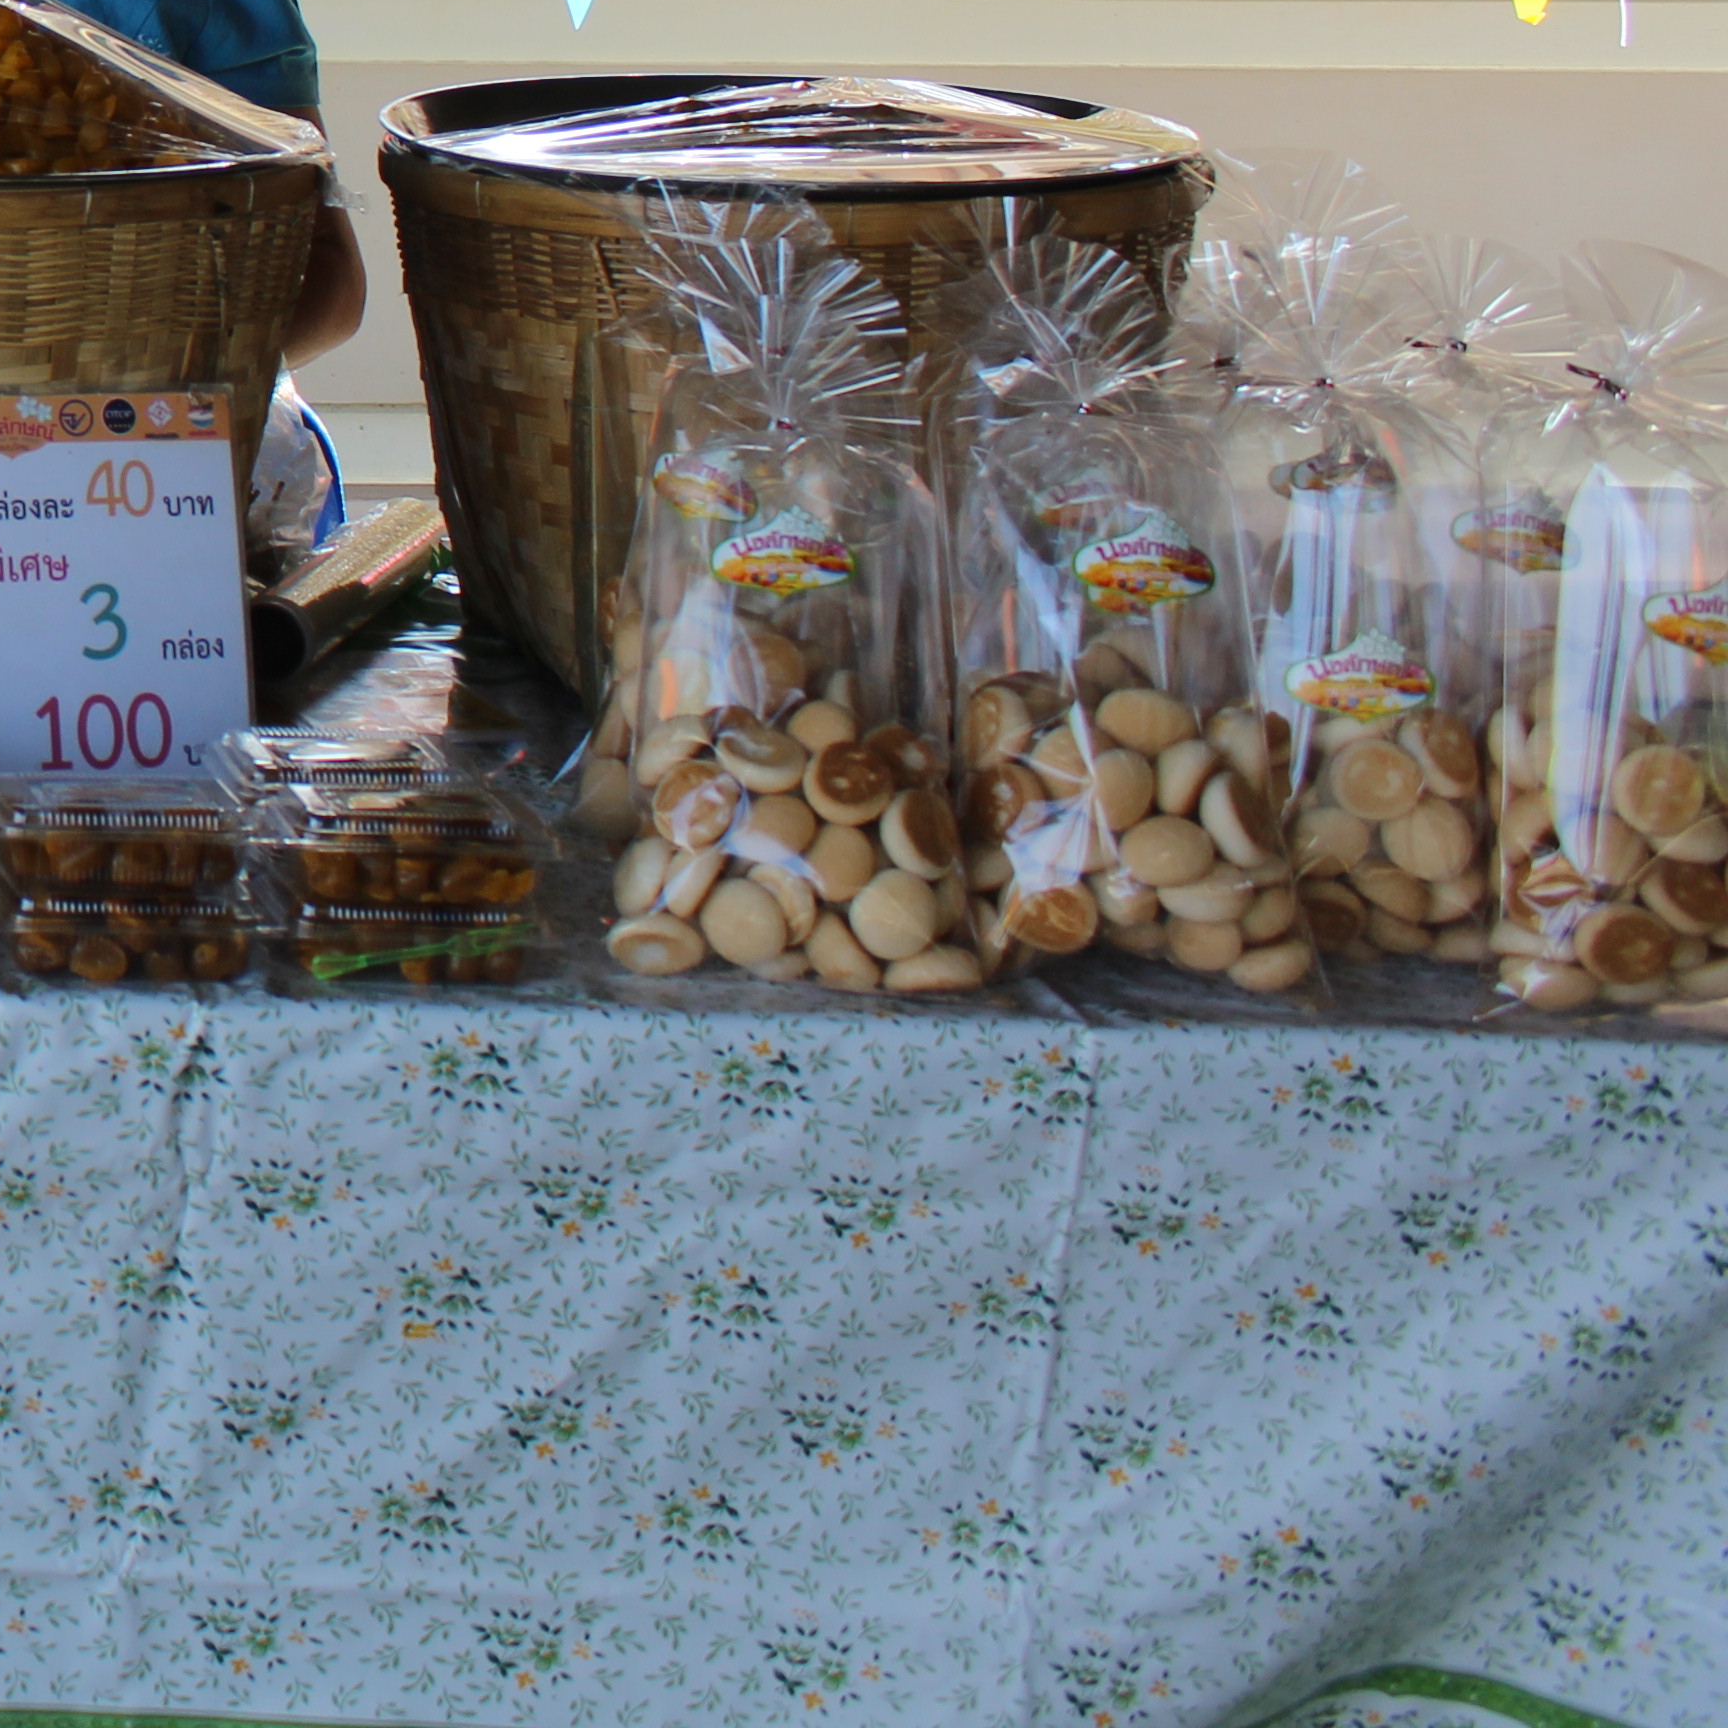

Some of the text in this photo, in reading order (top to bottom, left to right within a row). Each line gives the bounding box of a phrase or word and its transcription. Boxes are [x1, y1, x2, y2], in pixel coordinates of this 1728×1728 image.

[85, 458, 155, 518] 40
[163, 492, 215, 518] บาท
[79, 582, 225, 661] 3 กล่อง
[35, 691, 174, 772] 100
